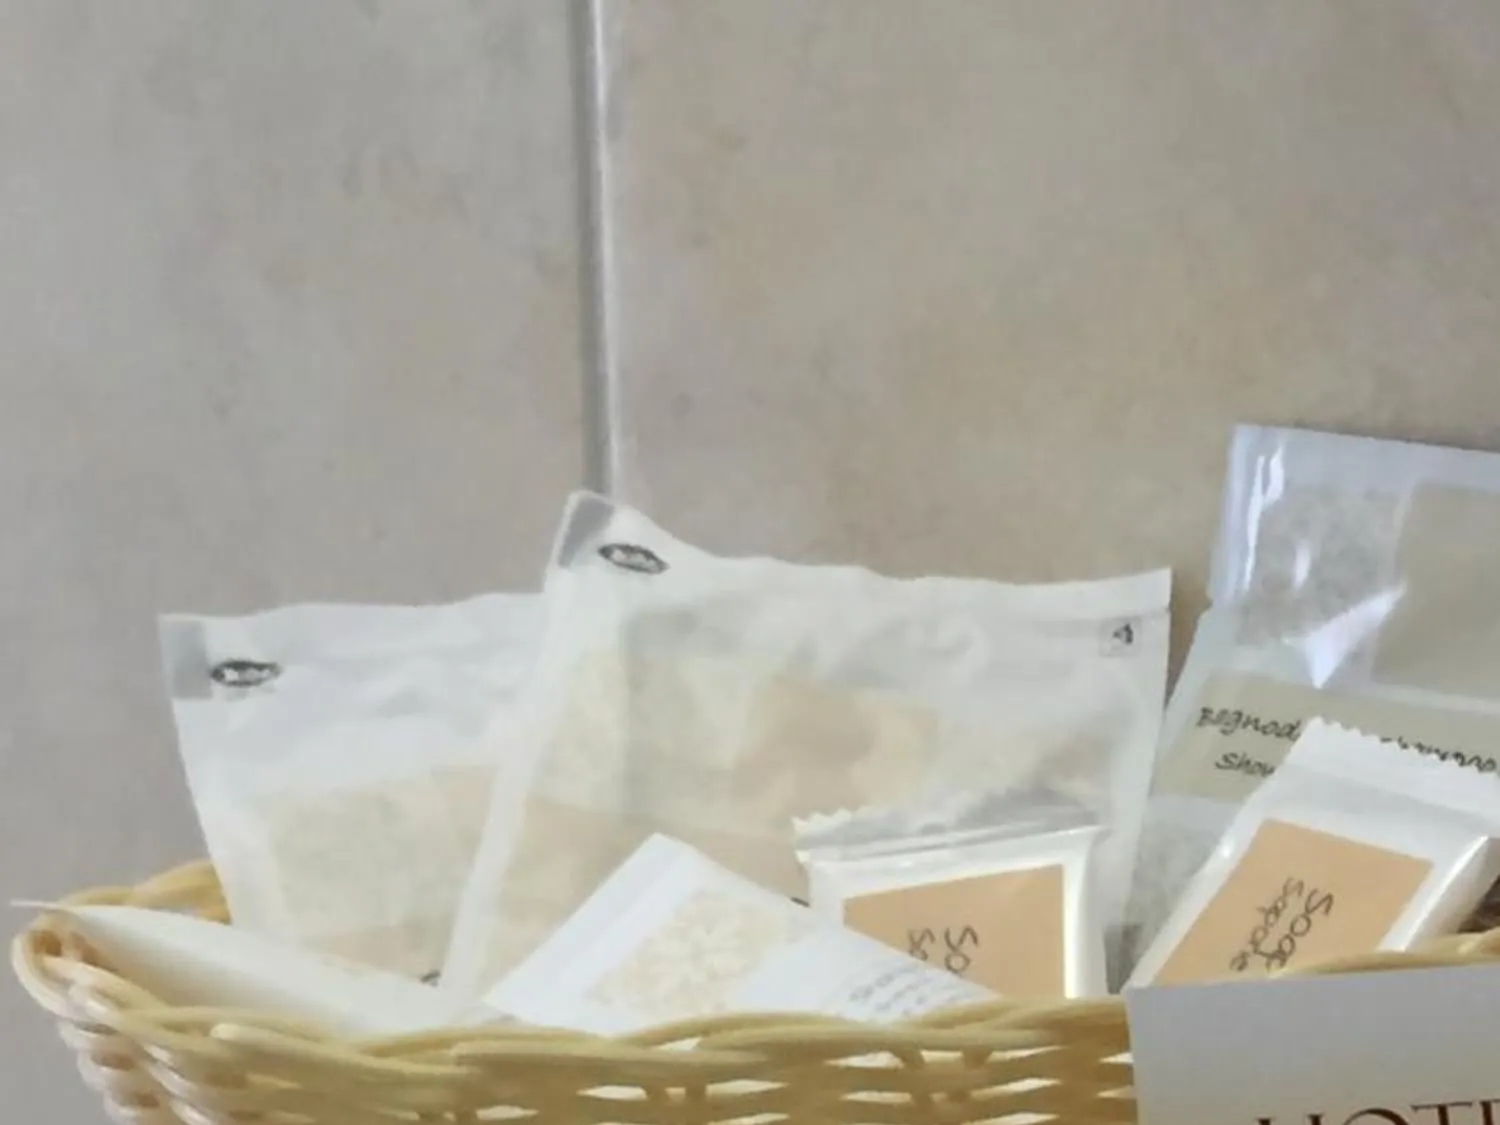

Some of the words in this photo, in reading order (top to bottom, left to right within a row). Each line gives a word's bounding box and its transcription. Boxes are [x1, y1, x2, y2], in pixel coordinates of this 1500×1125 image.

[1195, 706, 1304, 742] Bagnod
[1215, 751, 1277, 778] Show
[943, 924, 981, 976] So
[1254, 887, 1334, 972] Soap
